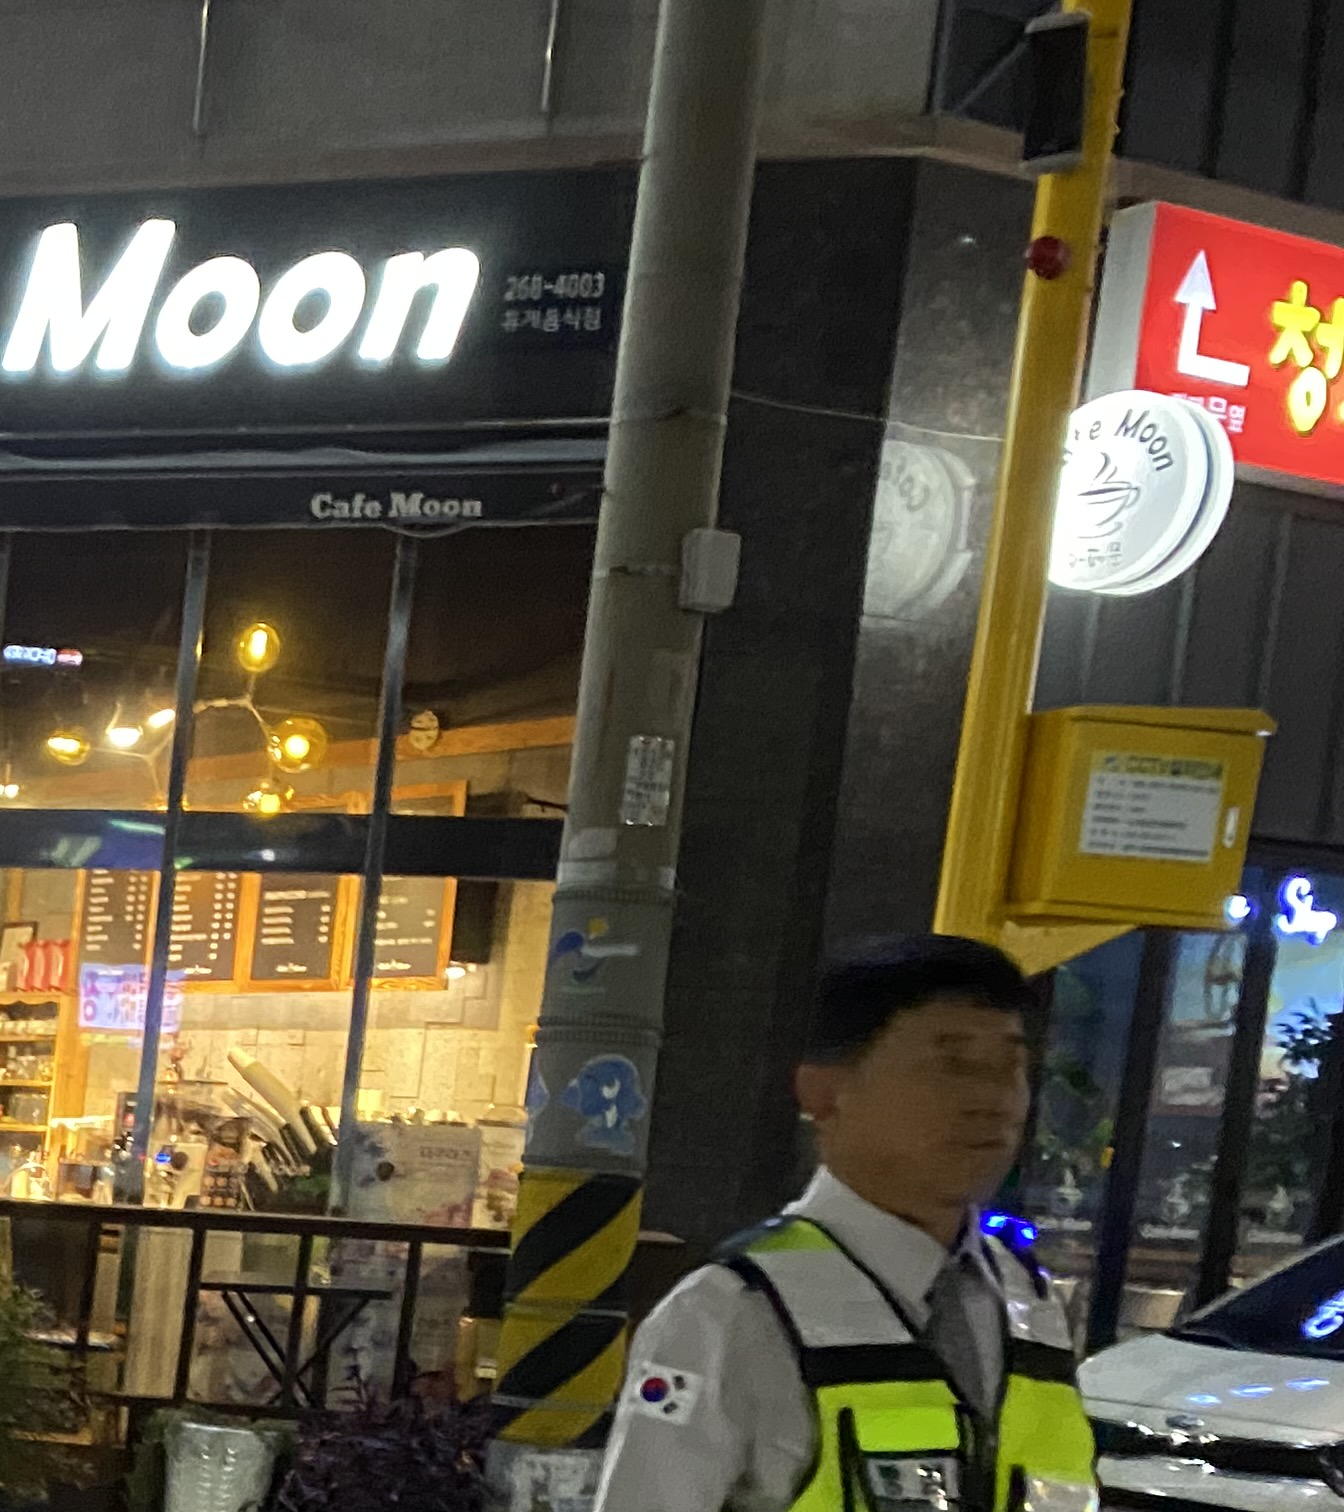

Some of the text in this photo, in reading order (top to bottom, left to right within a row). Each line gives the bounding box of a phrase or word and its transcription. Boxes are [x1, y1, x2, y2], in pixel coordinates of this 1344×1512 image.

[1, 218, 481, 372] Moon
[1114, 409, 1174, 471] Moon
[310, 492, 483, 520] Cafe Moon
